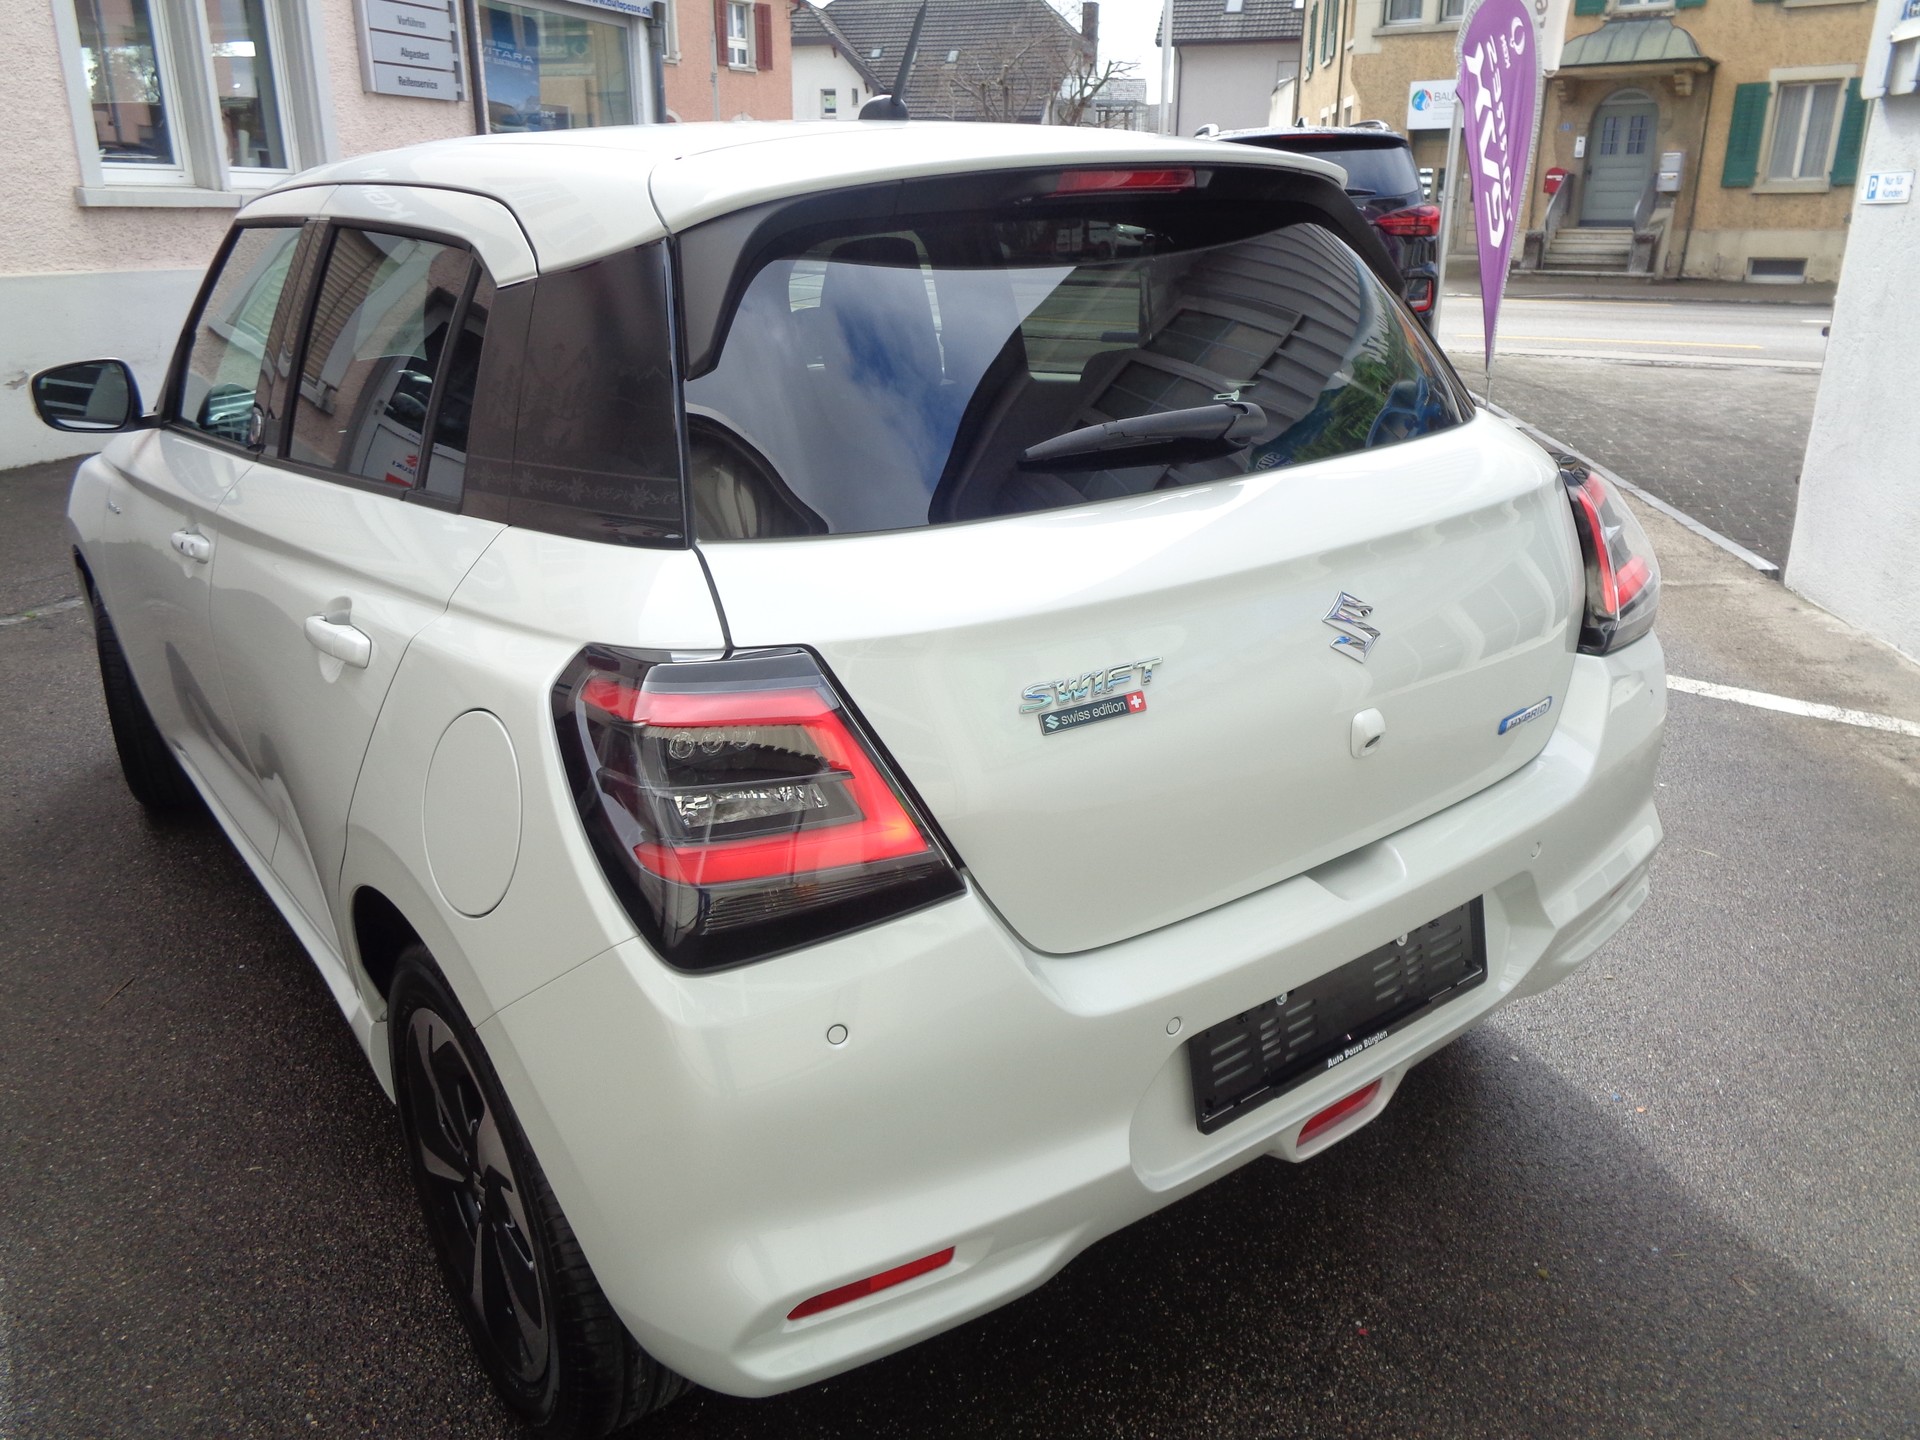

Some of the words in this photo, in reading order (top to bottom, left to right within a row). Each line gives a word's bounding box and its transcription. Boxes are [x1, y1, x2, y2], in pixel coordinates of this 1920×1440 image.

[398, 76, 438, 89] Reifenservice
[1019, 657, 1163, 714] SWIFT
[1061, 709, 1091, 725] swiss
[1092, 700, 1126, 717] edition
[1509, 703, 1547, 729] HYBRID
[1327, 1053, 1344, 1068] Auto
[1363, 1030, 1388, 1048] Bürglen
